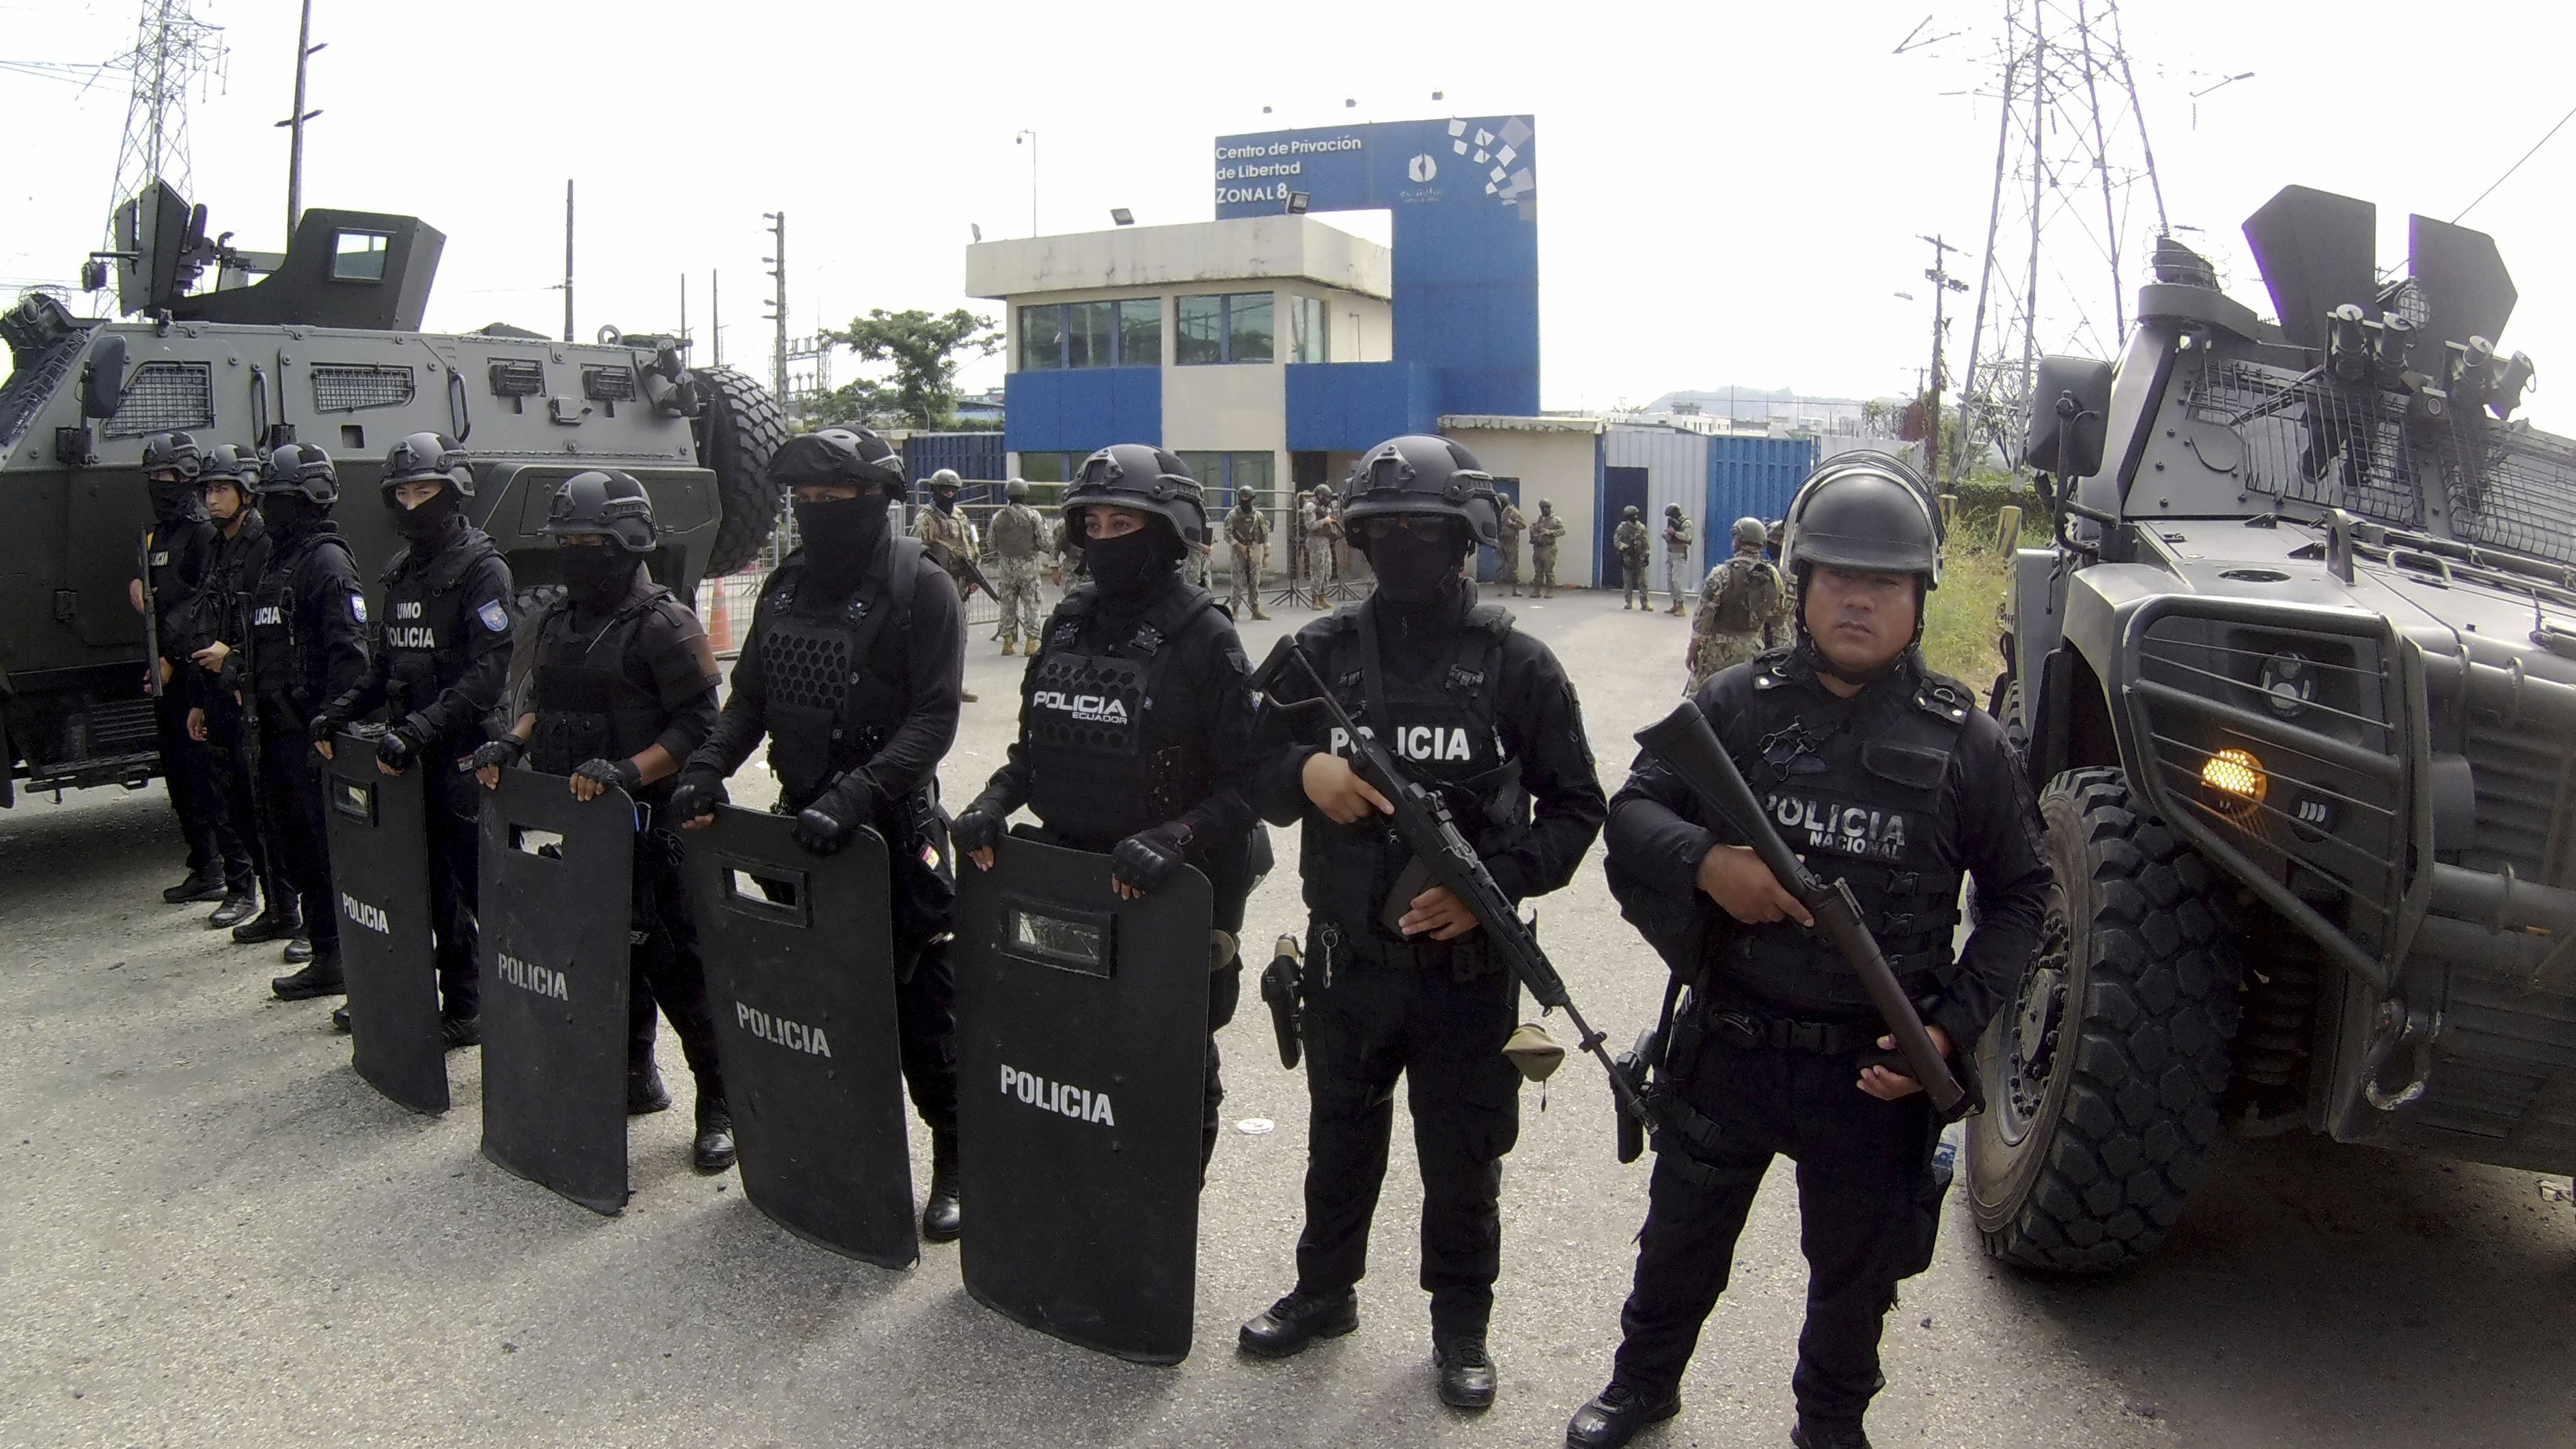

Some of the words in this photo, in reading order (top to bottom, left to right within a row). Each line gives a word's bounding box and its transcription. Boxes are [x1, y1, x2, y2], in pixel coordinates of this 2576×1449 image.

[1216, 145, 1266, 160] Centro
[1268, 142, 1289, 156] de
[1291, 135, 1362, 154] Privación
[1216, 167, 1236, 180] de
[1238, 161, 1301, 178] Libertad
[1216, 187, 1275, 204] ZONAL
[1277, 182, 1288, 199] 8
[254, 606, 282, 626] LICIA
[397, 601, 421, 620] UMO
[1033, 691, 1128, 717] POLICIA
[1072, 712, 1128, 725] ECUADOR
[1331, 726, 1471, 760] PICIA
[342, 892, 390, 935] POLICIA
[498, 952, 569, 1001] POLICIA
[736, 1001, 831, 1058] POLICIA
[1001, 1064, 1115, 1127] POLICIA
